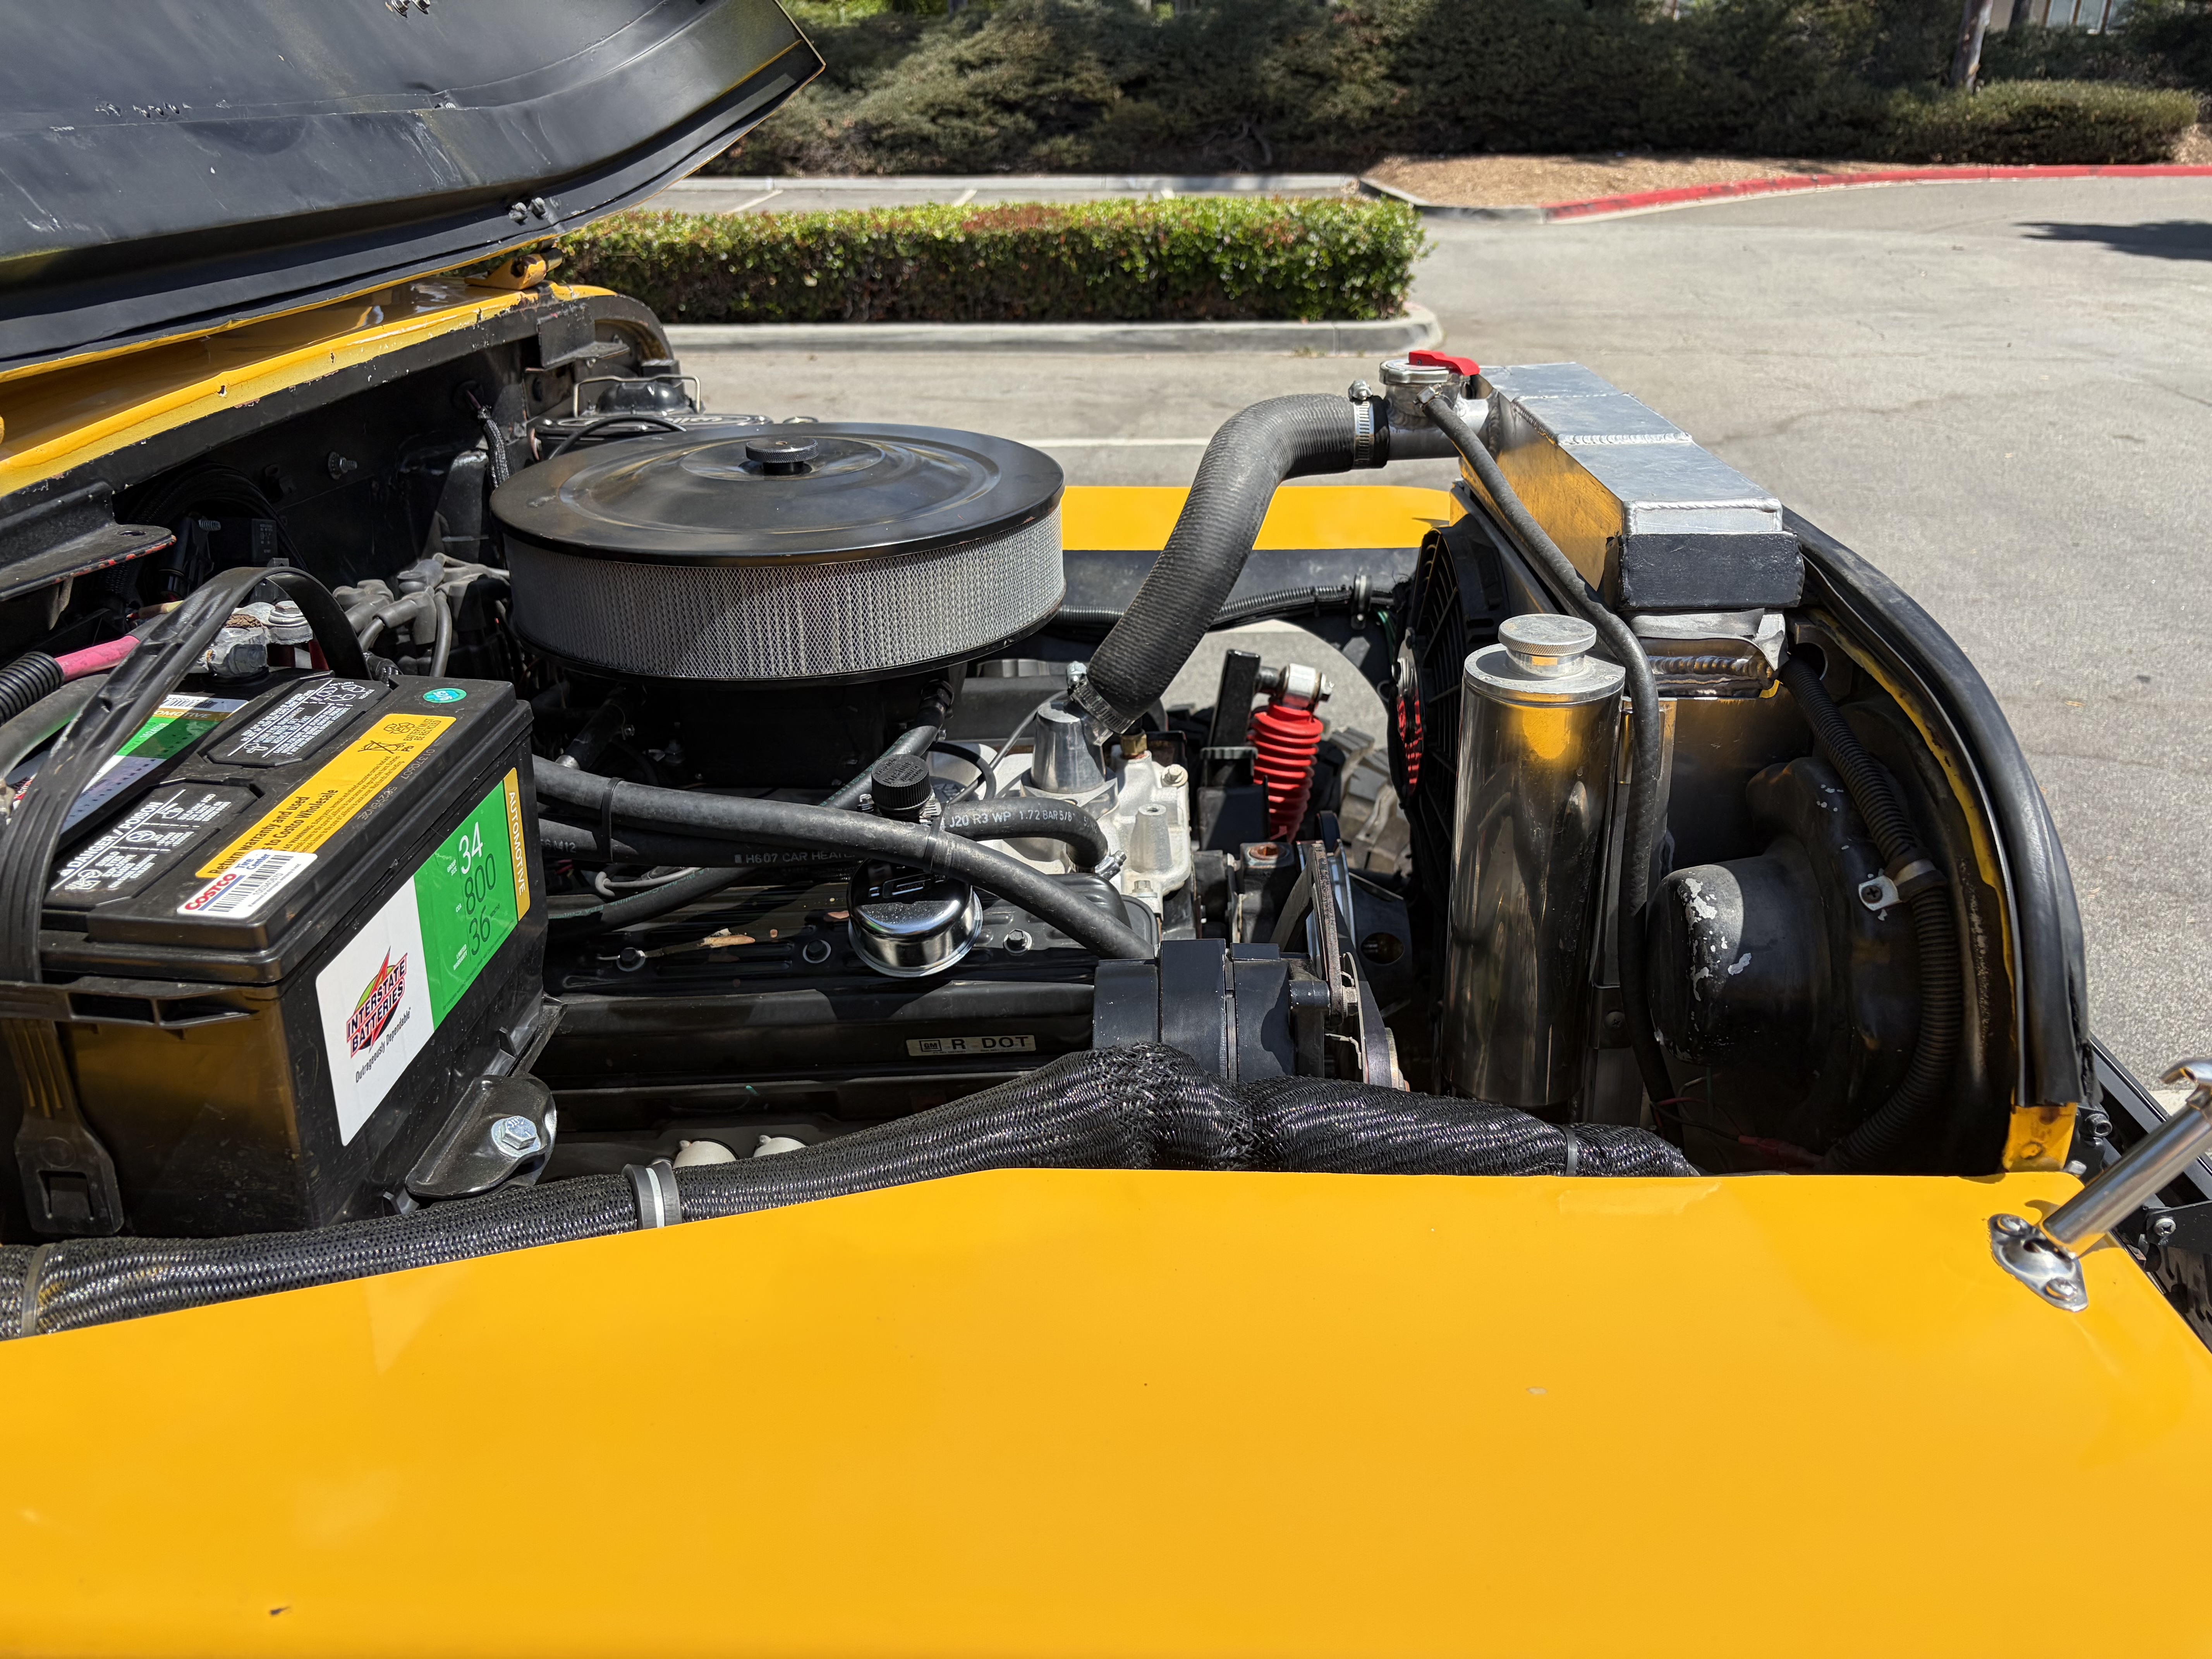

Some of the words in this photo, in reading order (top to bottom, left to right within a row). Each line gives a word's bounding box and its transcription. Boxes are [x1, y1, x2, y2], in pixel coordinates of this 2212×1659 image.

[68, 835, 118, 870] DANGER
[118, 802, 164, 830] POISON
[206, 848, 244, 874] Return
[238, 823, 279, 851] warranty
[273, 811, 292, 823] and
[286, 796, 311, 813] used
[272, 819, 305, 838] Costco
[294, 789, 338, 819] Wholesale
[949, 815, 970, 828] J20
[973, 813, 989, 825] R3
[992, 811, 1012, 823] WP
[1019, 810, 1041, 821] 1.72
[1042, 810, 1058, 820] BAR
[234, 858, 254, 869] Tire
[246, 854, 271, 870] Center
[459, 821, 483, 874] 34
[508, 792, 526, 896] AUTOMOTIVE
[746, 853, 778, 864] H607
[782, 852, 808, 862] CAR
[185, 873, 237, 910] COSTCO
[465, 853, 496, 915] 800
[469, 905, 491, 956] 36
[348, 959, 405, 1038] INTERSTATE
[352, 980, 404, 1053] BATTERIES
[356, 1041, 385, 1083] Outrageously
